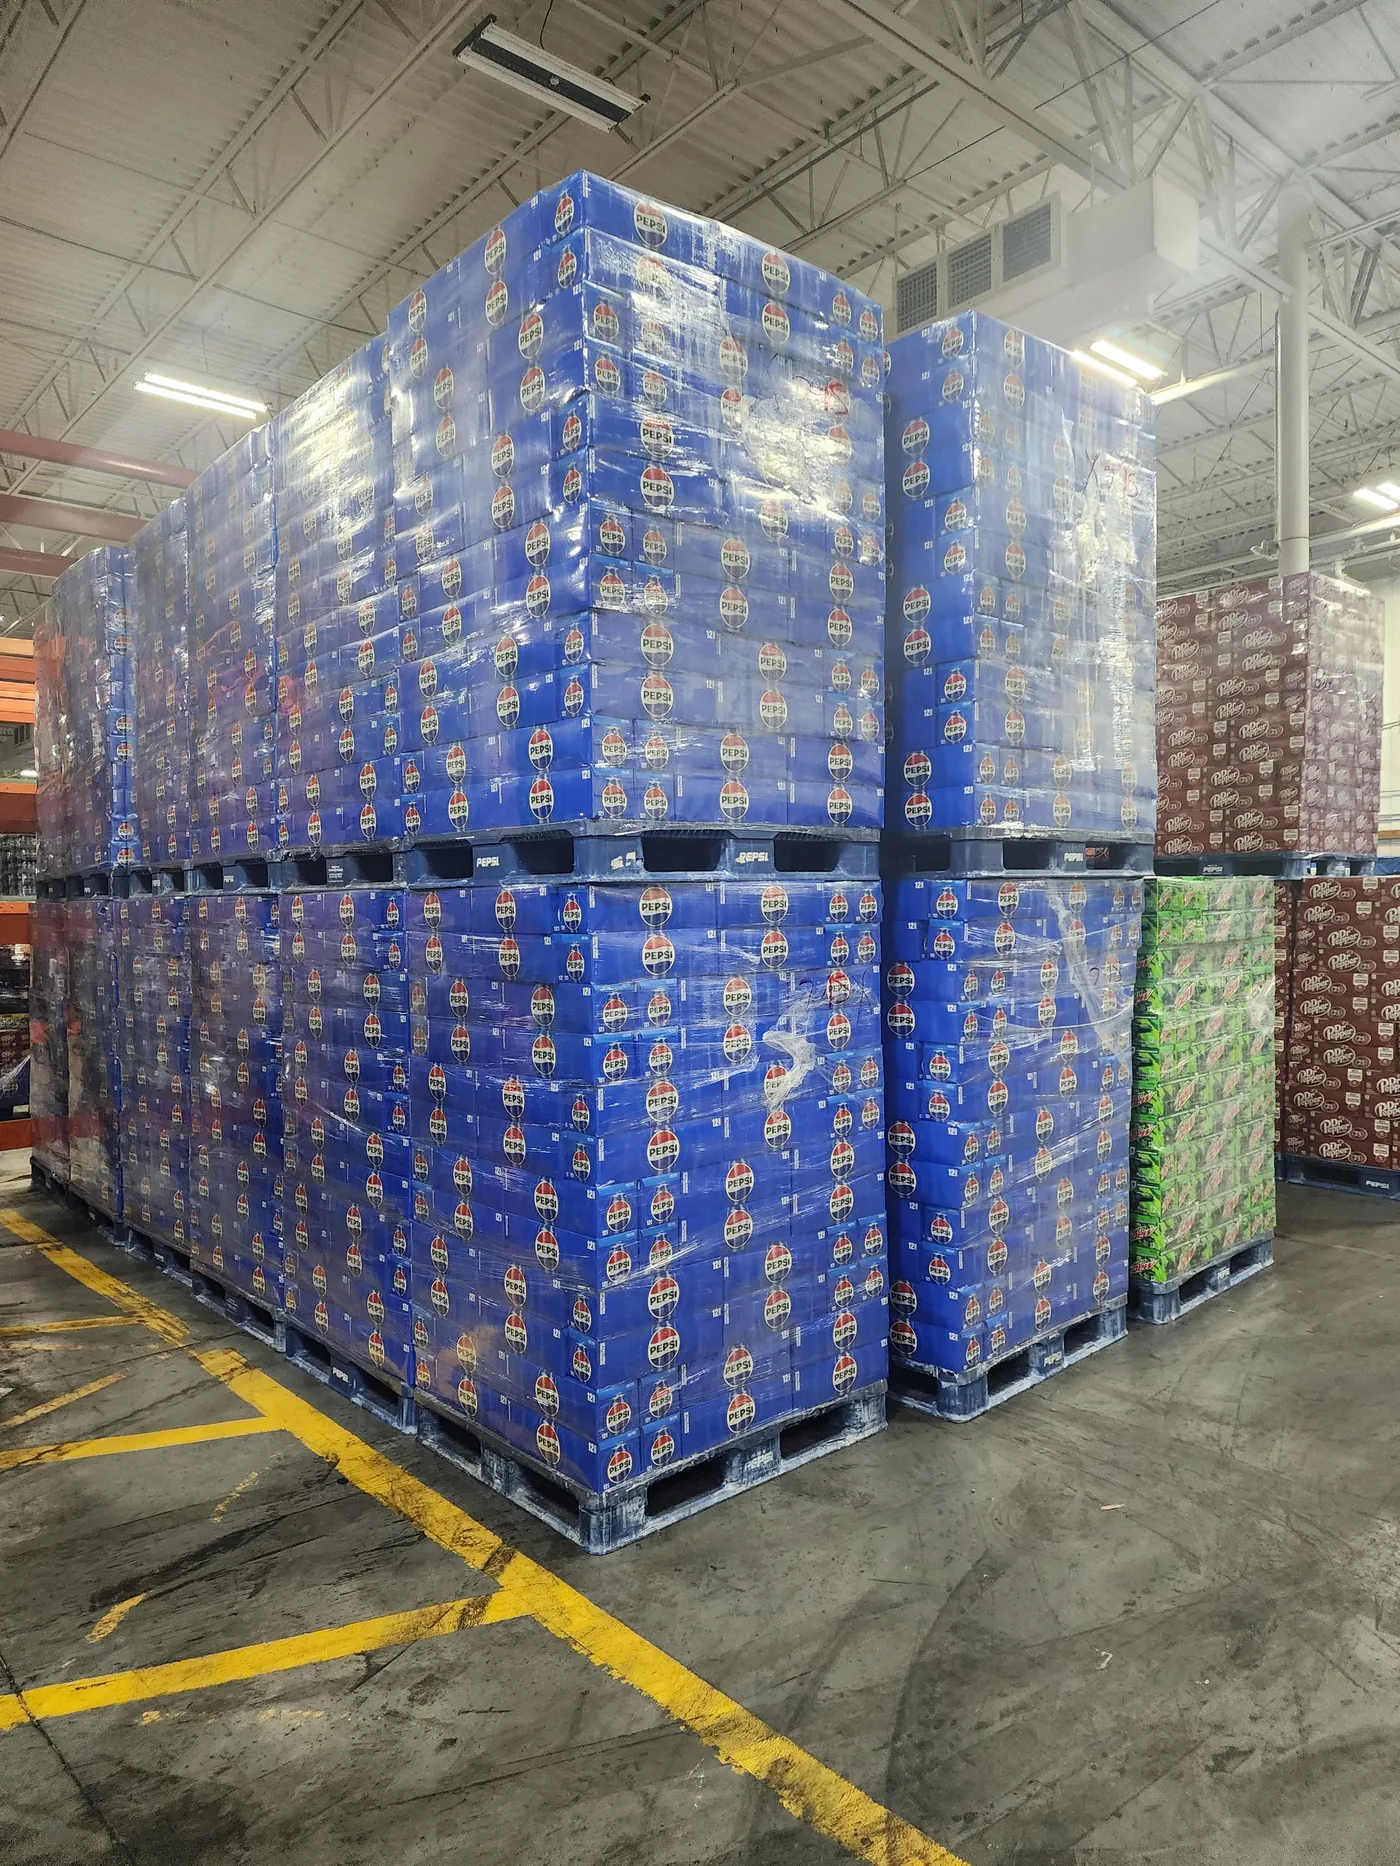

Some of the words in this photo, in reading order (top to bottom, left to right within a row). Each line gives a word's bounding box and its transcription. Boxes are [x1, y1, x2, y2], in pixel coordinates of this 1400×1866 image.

[555, 206, 574, 222] PEPSI
[636, 214, 665, 232] PEPSI
[486, 244, 505, 262] PEPSI
[558, 262, 576, 278] PEPSI
[764, 263, 789, 281] PEPSI
[487, 294, 508, 312] PEPSI
[410, 303, 425, 320] PEPSI
[595, 314, 618, 329] PEPSI
[764, 314, 789, 333] PEPSI
[519, 326, 542, 347] PEPSI
[943, 337, 962, 350] PEPSI
[596, 370, 619, 383] PEPSI
[522, 381, 545, 399] PEPSI
[564, 425, 580, 439] PEPSI
[642, 426, 672, 444] PEPSI
[904, 431, 928, 444] PEPSI
[493, 452, 514, 469] PEPSI
[904, 473, 928, 486] PEPSI
[564, 480, 580, 494] PEPSI
[642, 480, 672, 495] PEPSI
[494, 500, 514, 516] PEPSI
[946, 511, 965, 522] PEPSI
[602, 533, 624, 544] PEPSI
[527, 539, 549, 552] PEPSI
[723, 553, 748, 566] PEPSI
[831, 577, 852, 587] PEPSI
[527, 590, 549, 603] PEPSI
[721, 602, 747, 614] PEPSI
[905, 600, 929, 610] PEPSI
[359, 614, 374, 624] PEPSI
[830, 623, 851, 632] PEPSI
[565, 641, 583, 652] PEPSI
[643, 639, 672, 650] PEPSI
[905, 641, 930, 652] PEPSI
[497, 651, 517, 663] PEPSI
[760, 658, 785, 668] PEPSI
[946, 682, 964, 690] PEPSI
[565, 693, 583, 702] PEPSI
[643, 690, 672, 701] PEPSI
[340, 702, 353, 710] PEPSI
[498, 701, 518, 713] PEPSI
[422, 721, 437, 732] PEPSI
[946, 725, 964, 734] PEPSI
[530, 745, 552, 755] PEPSI
[722, 748, 748, 758] PEPSI
[830, 757, 851, 767] PEPSI
[906, 764, 930, 773] PEPSI
[360, 778, 376, 786] PEPSI
[1214, 772, 1237, 786] Pepper
[530, 795, 552, 804] PEPSI
[604, 796, 625, 805] PEPSI
[722, 795, 748, 805] PEPSI
[449, 805, 467, 815] PEPSI
[830, 802, 851, 810] PEPSI
[906, 806, 931, 814] PEPSI
[360, 818, 376, 826] PEPSI
[476, 856, 500, 868] PEPSI
[496, 906, 514, 914] PEPSI
[642, 902, 670, 911] PEPSI
[763, 900, 787, 909] PEPSI
[860, 903, 877, 911] PEPSI
[340, 907, 353, 915] PEPSI
[1308, 909, 1332, 922] Pepper
[1331, 933, 1358, 946] Pepper
[763, 945, 786, 954] PEPSI
[831, 947, 848, 955] PEPSI
[500, 953, 518, 962] PEPSI
[645, 950, 673, 961] PEPSI
[567, 961, 583, 970] PEPSI
[1042, 970, 1057, 978] PEPSI
[888, 977, 913, 986] PEPSI
[364, 986, 380, 995] PEPSI
[450, 996, 467, 1004] PEPSI
[726, 992, 750, 1003] PEPSI
[532, 1002, 554, 1012] PEPSI
[889, 1016, 914, 1024] PEPSI
[364, 1026, 380, 1036] PEPSI
[829, 1026, 849, 1037] PEPSI
[1327, 1028, 1353, 1040] Pepper
[452, 1040, 468, 1048] PEPSI
[534, 1051, 554, 1060] PEPSI
[990, 1054, 1008, 1062] PEPSI
[346, 1062, 359, 1070] PEPSI
[605, 1060, 626, 1071] PEPSI
[930, 1064, 949, 1072] PEPSI
[1061, 1080, 1076, 1088] PEPSI
[988, 1094, 1007, 1102] PEPSI
[1298, 1095, 1321, 1107] Pepper
[573, 1110, 588, 1120] PEPSI
[1324, 1122, 1349, 1134] Pepper
[504, 1140, 524, 1150] PEPSI
[649, 1146, 678, 1160] PEPSI
[832, 1156, 853, 1167] PEPSI
[455, 1171, 471, 1185] PEPSI
[727, 1176, 752, 1188] PEPSI
[890, 1175, 914, 1184] PEPSI
[367, 1184, 382, 1197] PEPSI
[1366, 1181, 1390, 1189] PEPSI
[536, 1194, 558, 1208] PEPSI
[831, 1198, 852, 1209] PEPSI
[652, 1203, 673, 1213] PEPSI
[609, 1211, 629, 1221] PEPSI
[990, 1211, 1008, 1222] PEPSI
[726, 1223, 751, 1236] PEPSI
[932, 1227, 950, 1237] PEPSI
[536, 1244, 558, 1258] PEPSI
[608, 1260, 629, 1272] PEPSI
[766, 1257, 790, 1269] PEPSI
[930, 1267, 949, 1277] PEPSI
[506, 1279, 526, 1295] PEPSI
[650, 1291, 677, 1304] PEPSI
[891, 1294, 916, 1305] PEPSI
[368, 1304, 384, 1316] PEPSI
[766, 1304, 790, 1316] PEPSI
[573, 1310, 590, 1322] PEPSI
[506, 1326, 526, 1343] PEPSI
[835, 1324, 856, 1336] PEPSI
[891, 1332, 916, 1344] PEPSI
[368, 1343, 384, 1356] PEPSI
[650, 1339, 677, 1354] PEPSI
[573, 1359, 590, 1371] PEPSI
[834, 1368, 856, 1381] PEPSI
[459, 1391, 476, 1406] PEPSI
[536, 1387, 559, 1403] PEPSI
[728, 1405, 754, 1419] PEPSI
[608, 1412, 630, 1425] PEPSI
[538, 1434, 559, 1453] PEPSI
[652, 1444, 673, 1456] PEPSI
[610, 1459, 631, 1474] PEPSI
